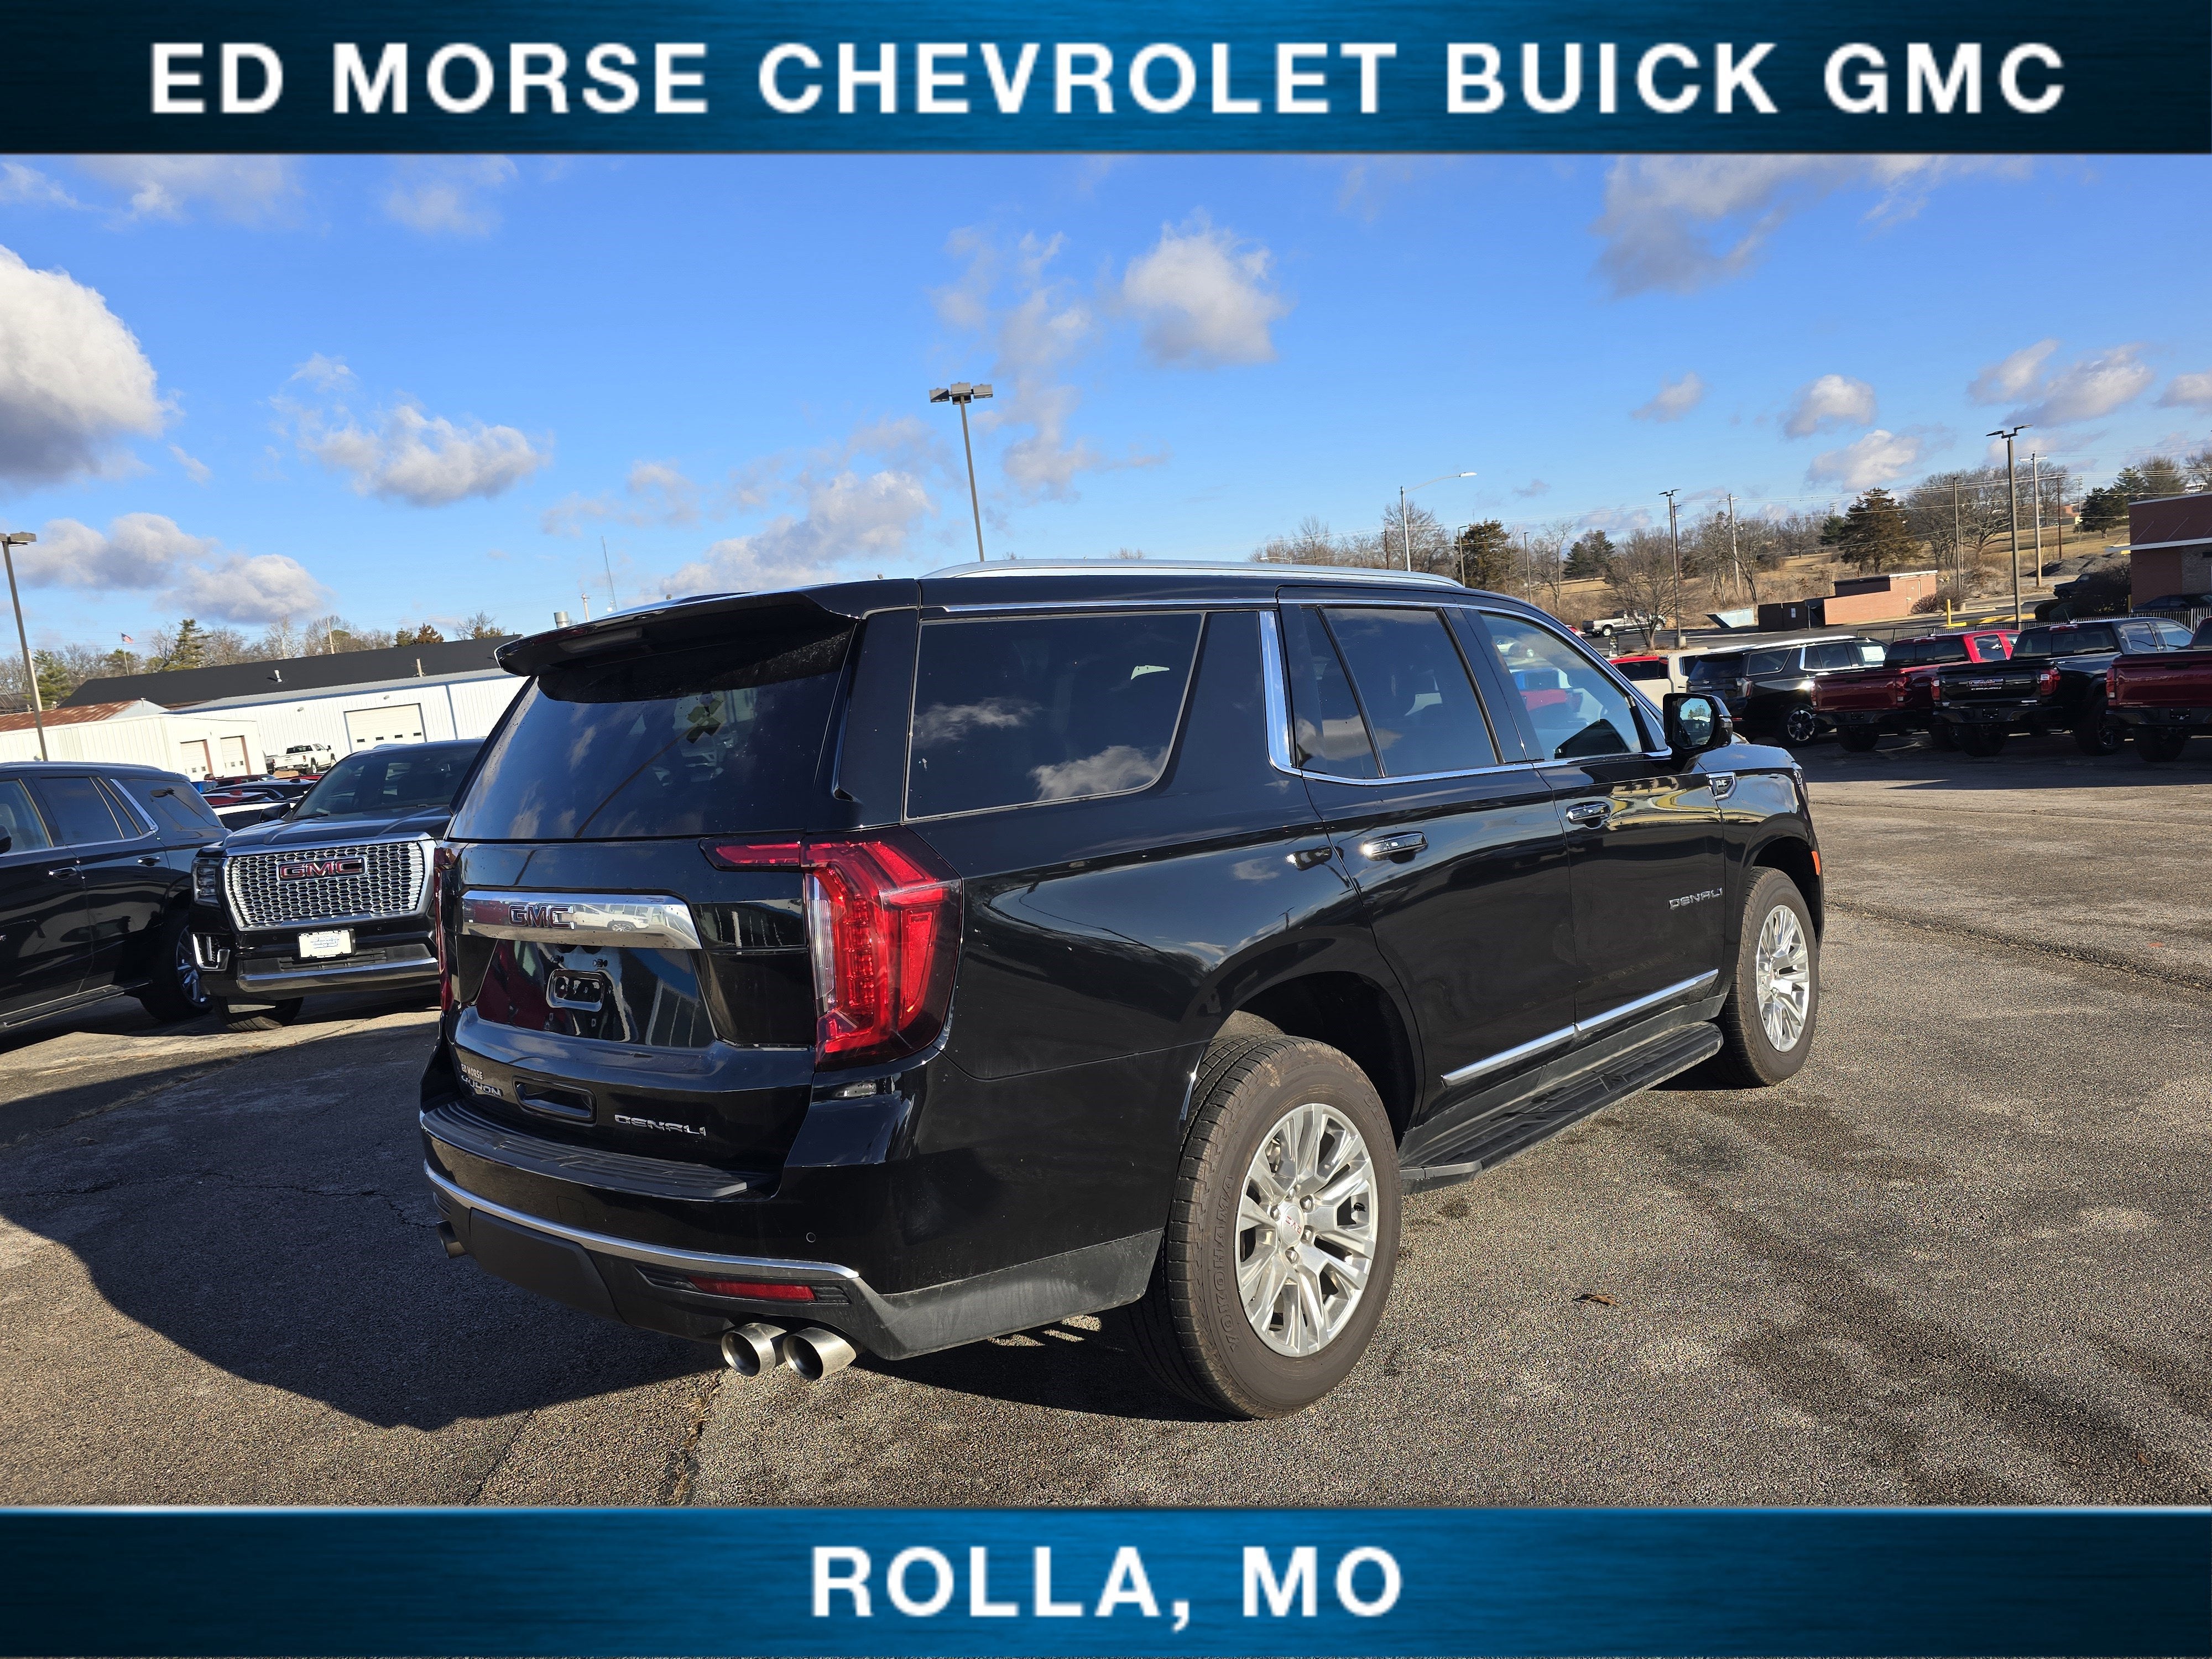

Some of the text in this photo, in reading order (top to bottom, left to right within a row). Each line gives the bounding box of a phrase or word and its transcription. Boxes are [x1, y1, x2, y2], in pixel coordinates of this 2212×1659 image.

[280, 859, 362, 879] GMC
[1669, 888, 1723, 910] DENALI
[509, 902, 575, 930] GMC
[467, 1066, 483, 1080] MORSE
[614, 1114, 706, 1136] DENALI
[1213, 1175, 1240, 1353] YOKOHAMA
